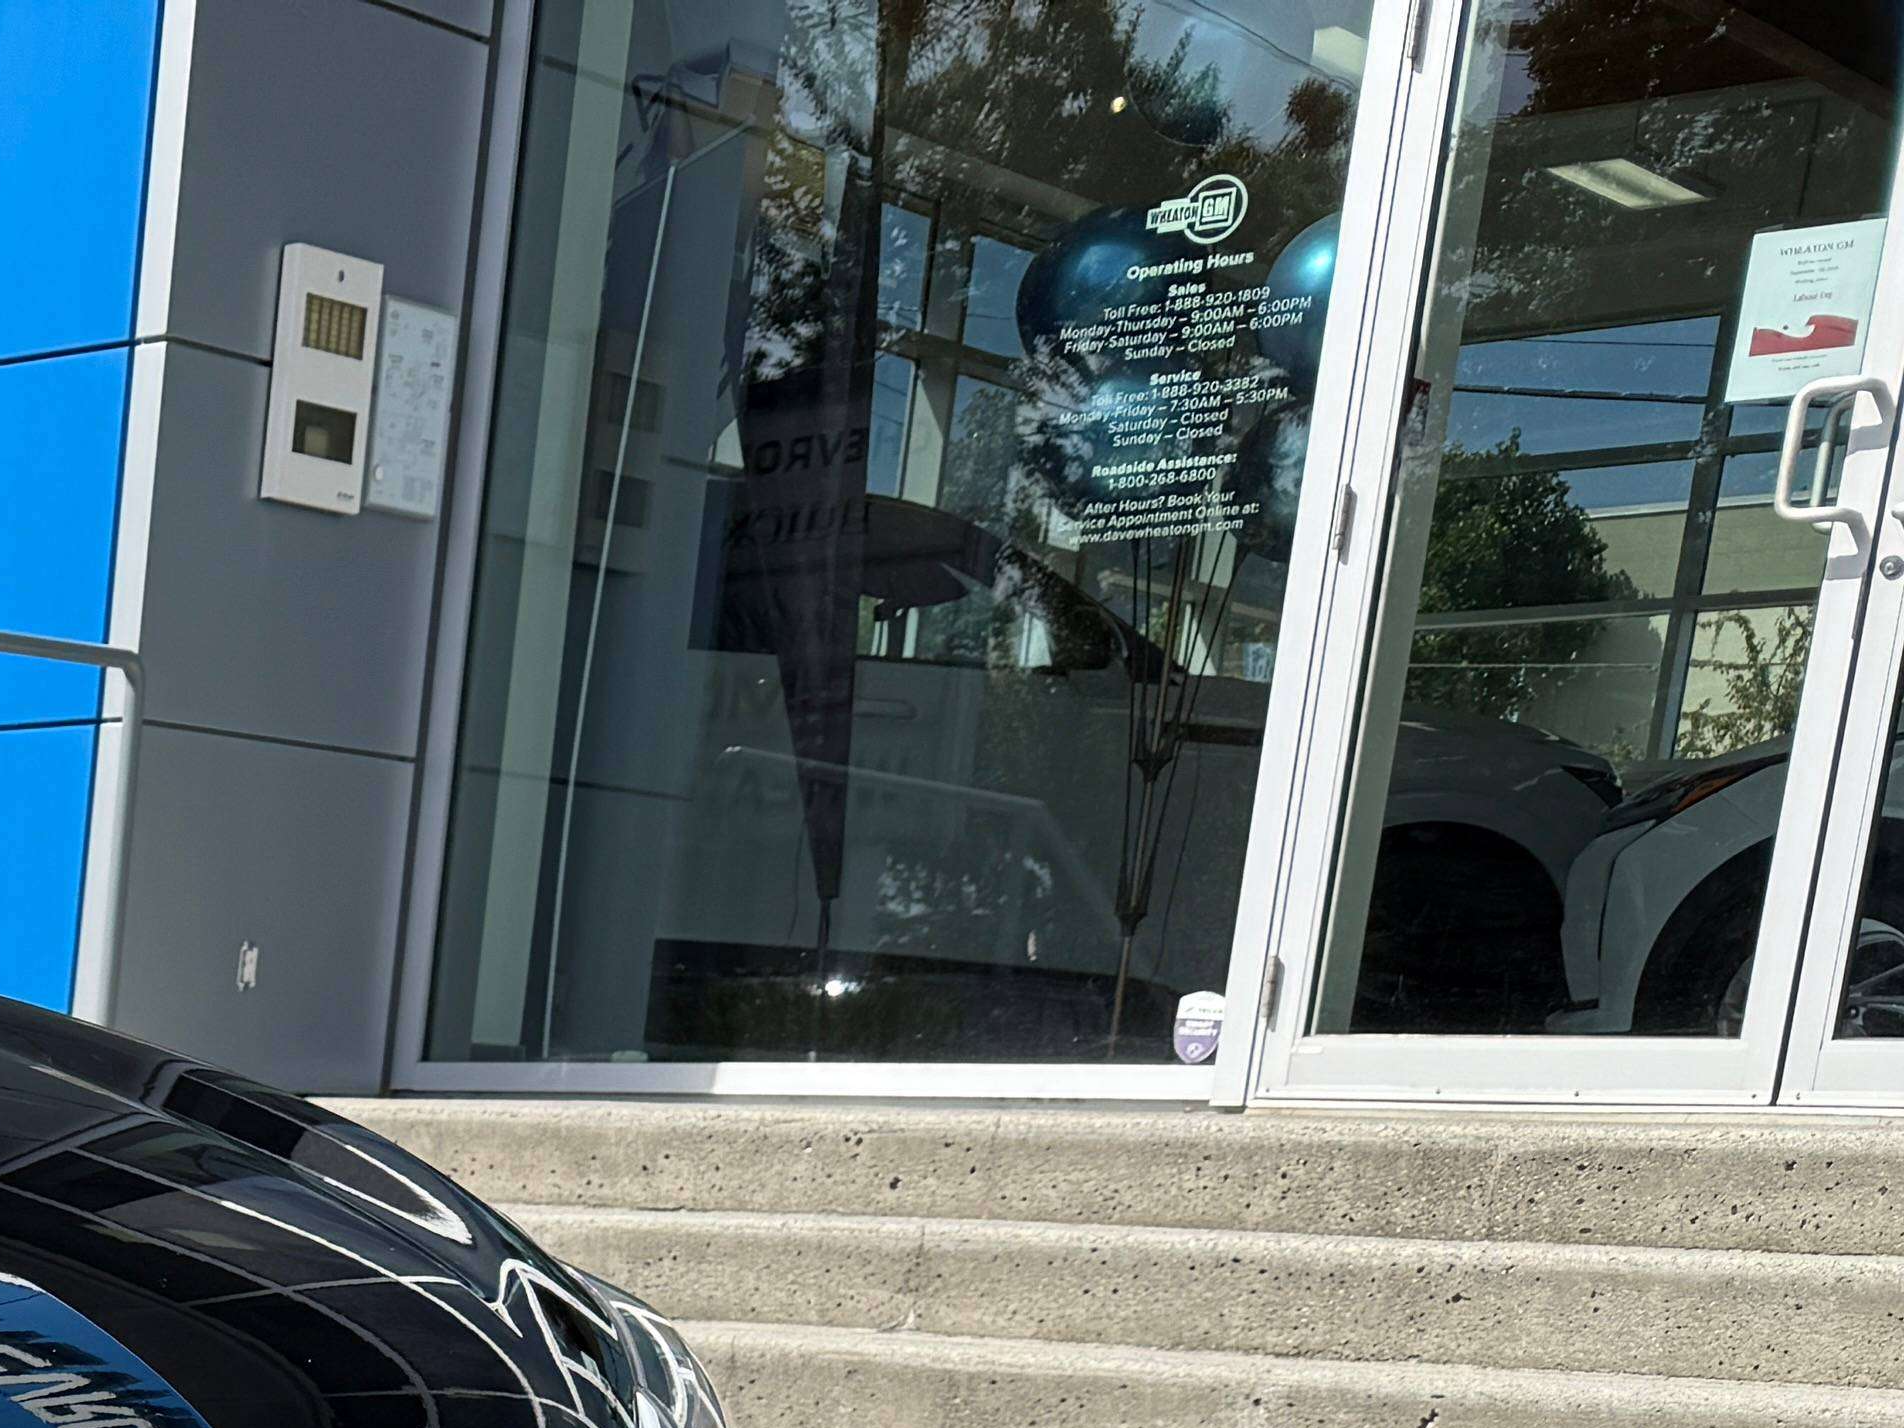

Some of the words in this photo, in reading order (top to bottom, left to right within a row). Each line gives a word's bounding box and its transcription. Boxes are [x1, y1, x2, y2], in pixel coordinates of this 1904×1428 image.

[1151, 203, 1200, 225] WHEATON
[1204, 196, 1229, 219] GM
[1126, 257, 1203, 283] Operating
[1207, 250, 1255, 268] Hours
[1168, 282, 1206, 297] Sales
[1103, 307, 1125, 321] Toll
[1127, 302, 1162, 317] Free:
[1164, 286, 1270, 313] 1-888-920-1809
[1059, 315, 1177, 341] Monday-Thursday
[1191, 306, 1245, 323] 9:00AM
[1258, 295, 1312, 315] 6:00PM
[1063, 332, 1167, 354] Friday-Saturday
[1181, 322, 1235, 339] 9:00AM
[1249, 312, 1304, 331] 6:00PM
[1124, 345, 1174, 361] Sunday
[1188, 335, 1235, 353] Closed
[1149, 370, 1202, 386] Service
[1152, 375, 1260, 401] 1-888-920-3382
[1059, 404, 1157, 426] Monday-Friday
[1170, 396, 1221, 413] 7:30AM
[1236, 387, 1289, 406] 5:30PM
[1107, 417, 1168, 435] Saturday
[1180, 409, 1229, 427] Closed
[1112, 431, 1162, 448] Sunday
[1176, 424, 1224, 441] Closed
[1092, 461, 1155, 478] Roadside
[1156, 453, 1238, 472] Assistance:
[1108, 467, 1217, 491] 1-800-268-6800
[1084, 502, 1117, 516] After
[1119, 496, 1165, 512] Hours?
[1167, 493, 1203, 507] Book
[1204, 490, 1236, 504] Your
[1107, 509, 1193, 530] Appointment
[1195, 504, 1239, 519] Online
[1240, 502, 1260, 514] at:
[1068, 517, 1244, 547] www.davewheatongm.com
